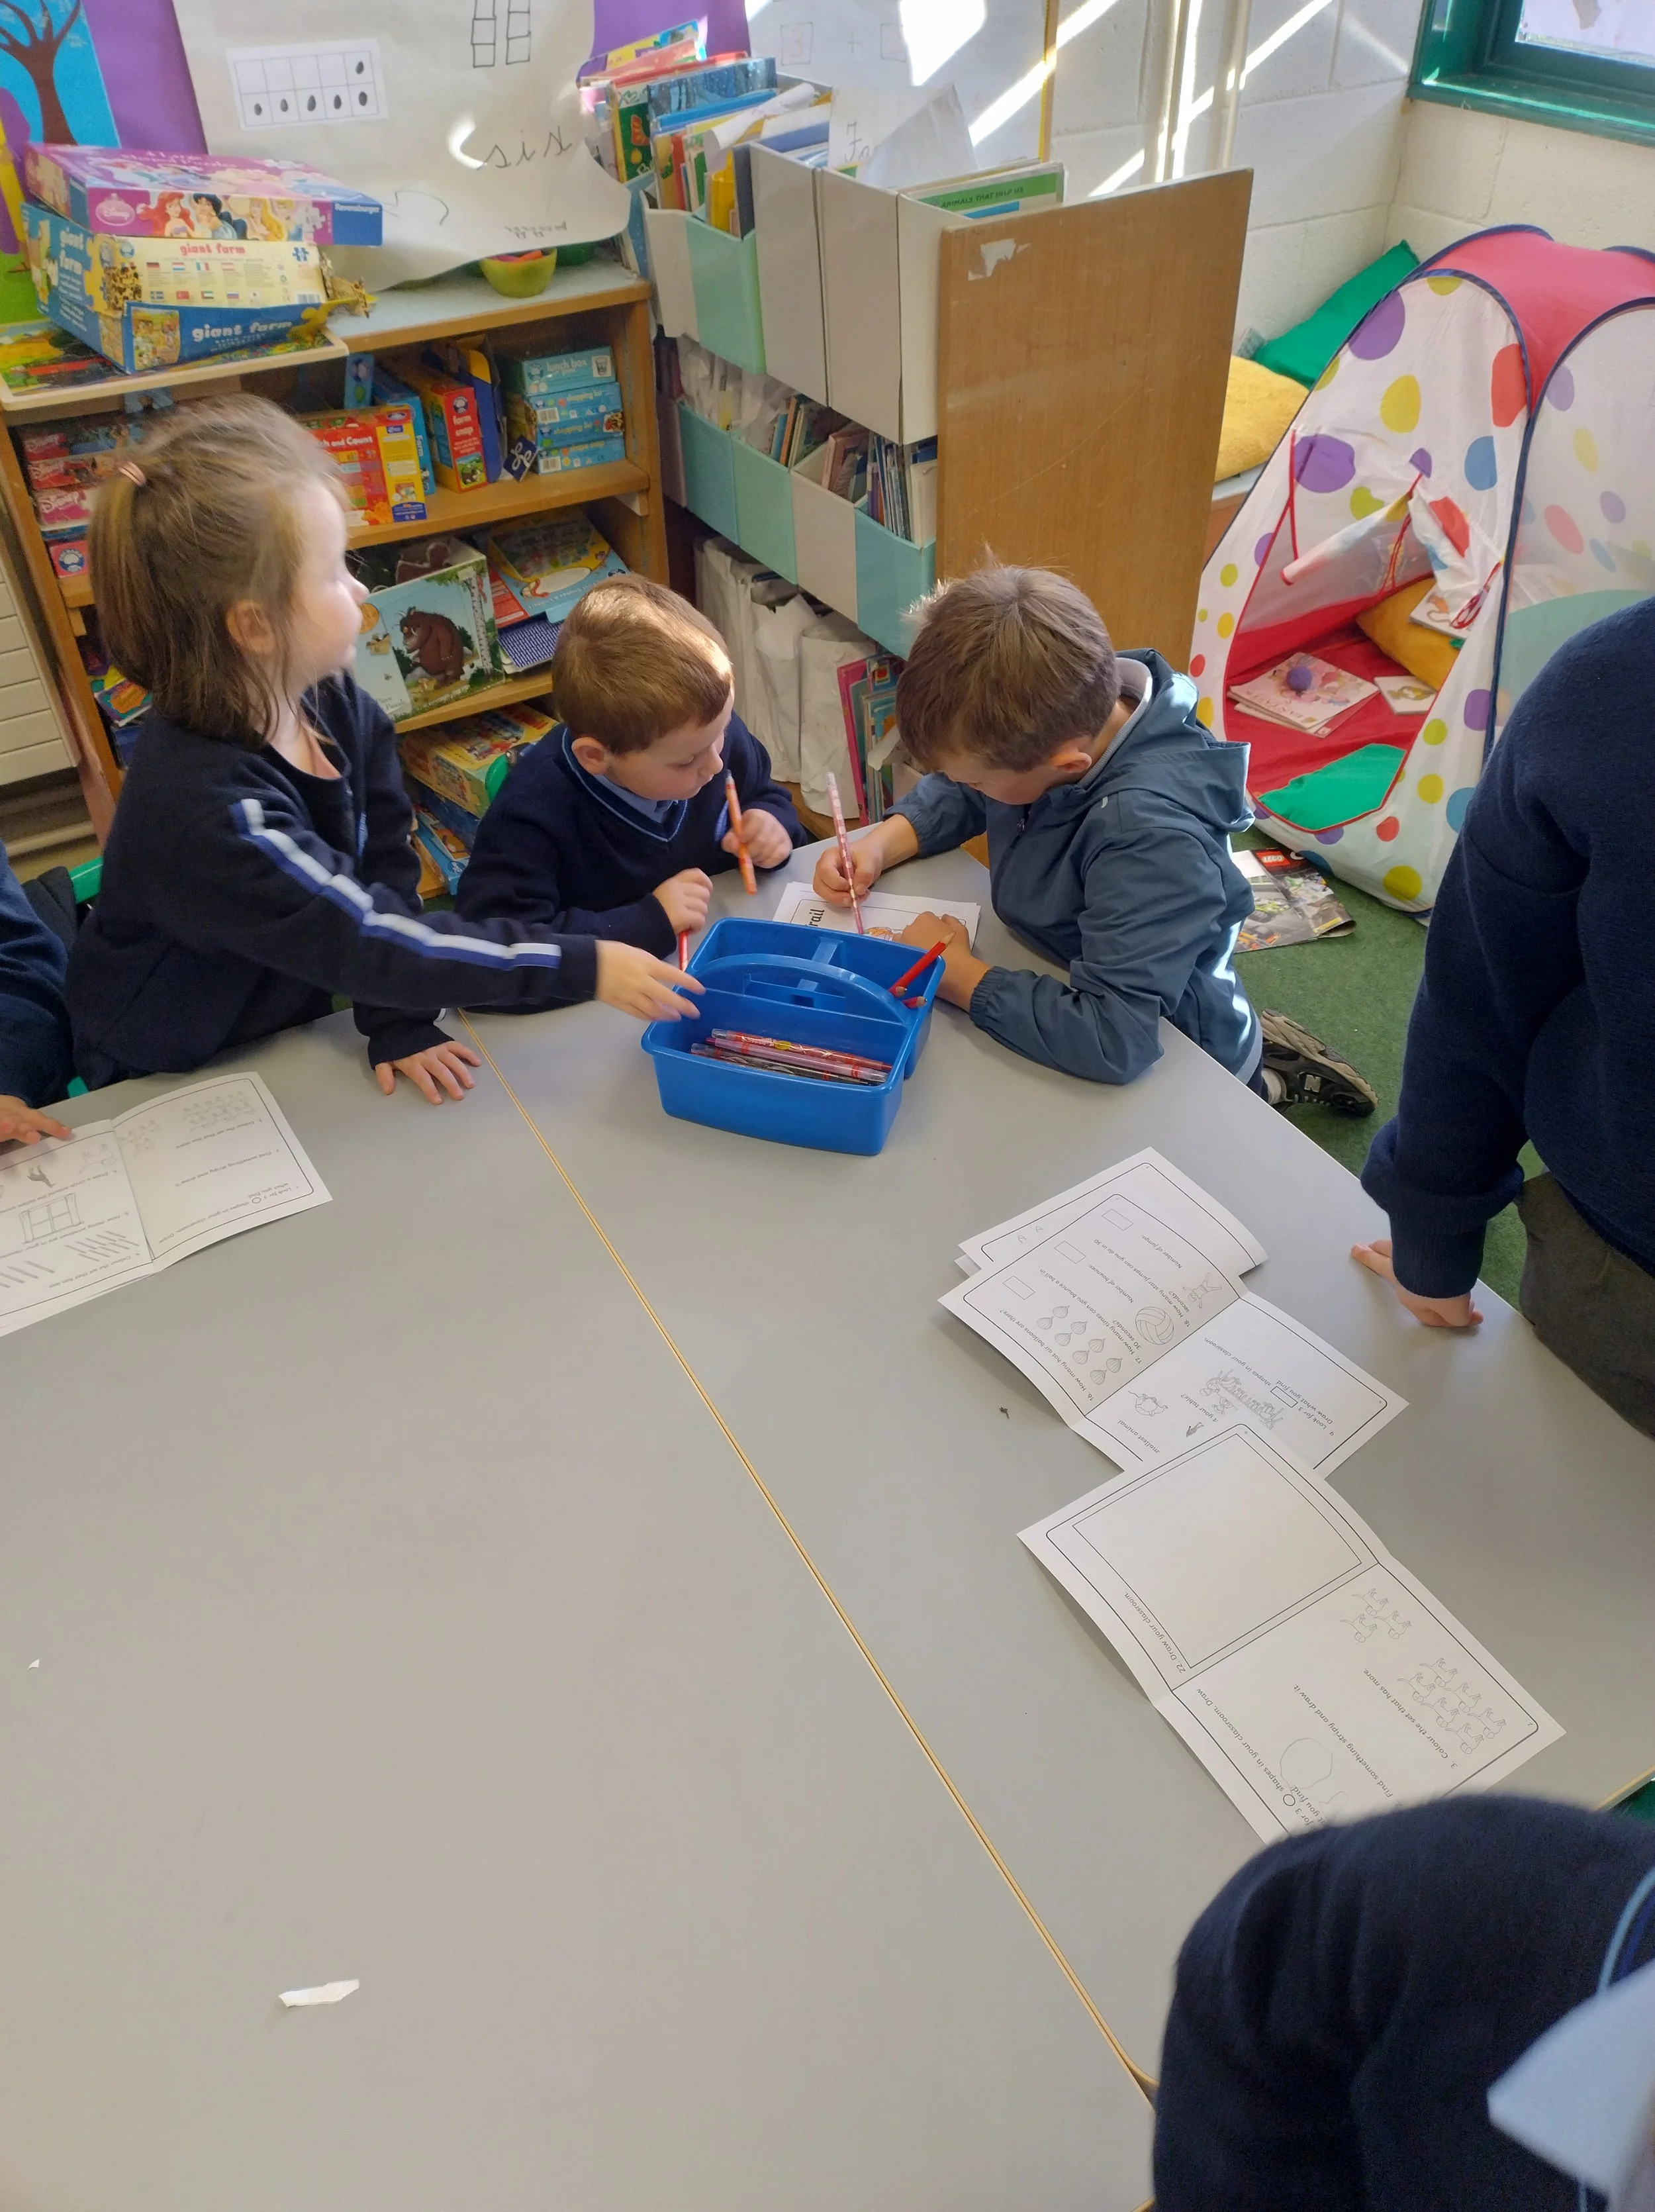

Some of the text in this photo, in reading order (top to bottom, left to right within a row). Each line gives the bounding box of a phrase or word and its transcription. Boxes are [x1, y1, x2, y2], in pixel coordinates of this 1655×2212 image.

[941, 196, 974, 209] ANIMALS
[974, 192, 995, 201] THAT
[1014, 185, 1024, 195] US
[60, 226, 85, 250] giant
[179, 242, 246, 256] giant farm
[192, 321, 293, 342] giant farm
[546, 358, 588, 371] lunch box
[453, 416, 472, 425] farm
[346, 436, 373, 446] Count
[808, 908, 826, 926] rail
[1140, 1234, 1159, 1249] jumps:
[1113, 1253, 1125, 1261] you
[1123, 1260, 1134, 1269] can
[1162, 1251, 1182, 1269] Number
[1043, 1272, 1056, 1282] ball
[1088, 1264, 1110, 1282] bounces:
[1133, 1267, 1151, 1283] jumps
[1059, 1282, 1077, 1298] bounce
[1147, 1281, 1159, 1290] star
[1076, 1296, 1088, 1306] you
[1114, 1285, 1135, 1304] Number
[1158, 1289, 1174, 1305] many
[1168, 1291, 1190, 1312] seconds?
[999, 1310, 1016, 1322] there?
[1086, 1304, 1096, 1314] can
[1172, 1304, 1184, 1318] How
[1014, 1320, 1025, 1329] are
[1096, 1313, 1110, 1327] times
[1024, 1327, 1045, 1347] balloons
[1109, 1325, 1124, 1341] many
[1112, 1320, 1142, 1350] 30 seconds?
[1122, 1341, 1135, 1355] How
[1204, 1337, 1232, 1357] classroom.
[1051, 1353, 1062, 1363] hot
[1231, 1355, 1247, 1367] your
[1061, 1361, 1076, 1378] many
[1074, 1377, 1086, 1392] How
[1251, 1370, 1272, 1386] shapes
[1180, 1393, 1200, 1408] table?
[1275, 1380, 1333, 1425] Draw what you find.
[1198, 1407, 1214, 1419] your
[1312, 1417, 1327, 1430] Look
[1117, 1419, 1160, 1453] mallest animal.
[1124, 1592, 1186, 1674] 22. Draw your classroom.
[1196, 1688, 1213, 1706] Draw
[1299, 1692, 1317, 1709] draw
[1213, 1705, 1243, 1741] classroom.
[1313, 1709, 1329, 1723] and
[1363, 1668, 1458, 1769] 3. Colour the set that has more.
[1327, 1722, 1347, 1743] stripy
[1241, 1742, 1259, 1758] your
[1256, 1758, 1264, 1768] in
[1346, 1743, 1379, 1780] something
[1262, 1766, 1285, 1792] shapes
[1376, 1780, 1394, 1798] Find
[1290, 1784, 1320, 1817] you find.
[1300, 1815, 1314, 1826] for
